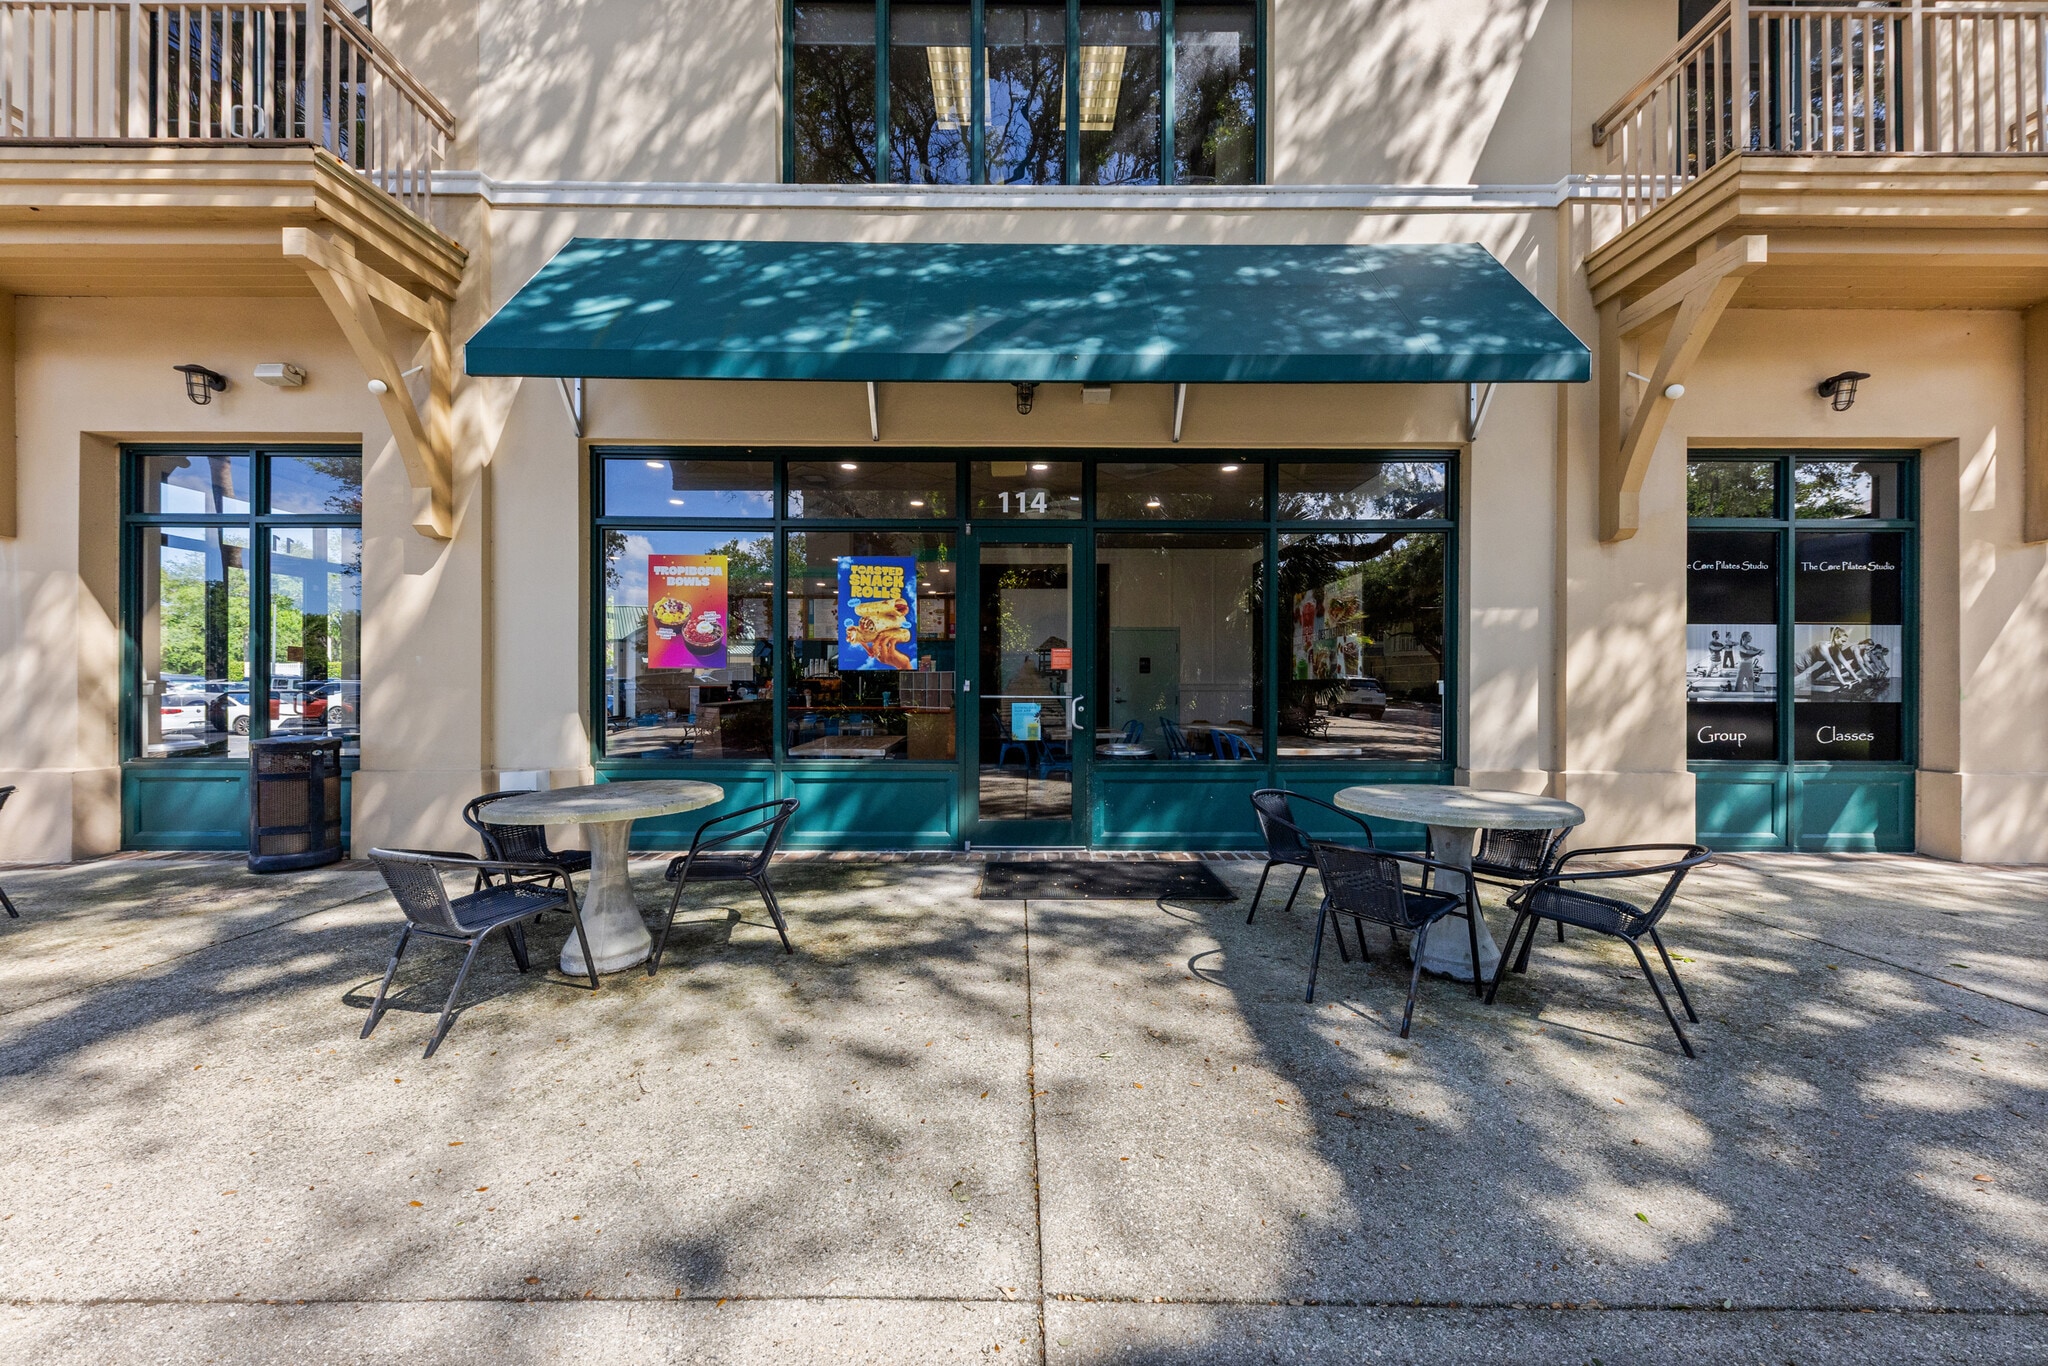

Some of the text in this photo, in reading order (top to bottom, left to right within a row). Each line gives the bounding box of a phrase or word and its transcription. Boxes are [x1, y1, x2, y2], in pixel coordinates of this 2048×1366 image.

[998, 491, 1048, 514] 114
[653, 566, 723, 576] TROPIBORA
[850, 565, 904, 576] TOASTED
[1692, 560, 1714, 571] Core
[1715, 560, 1741, 571] Pilates
[1741, 560, 1769, 571] Studio
[1801, 561, 1895, 572] The Core Pilates Studio
[666, 577, 710, 587] BOWLS
[849, 574, 905, 588] SNACK
[850, 586, 902, 599] ROLLS
[1697, 725, 1747, 748] Group
[1816, 725, 1875, 744] Classes
